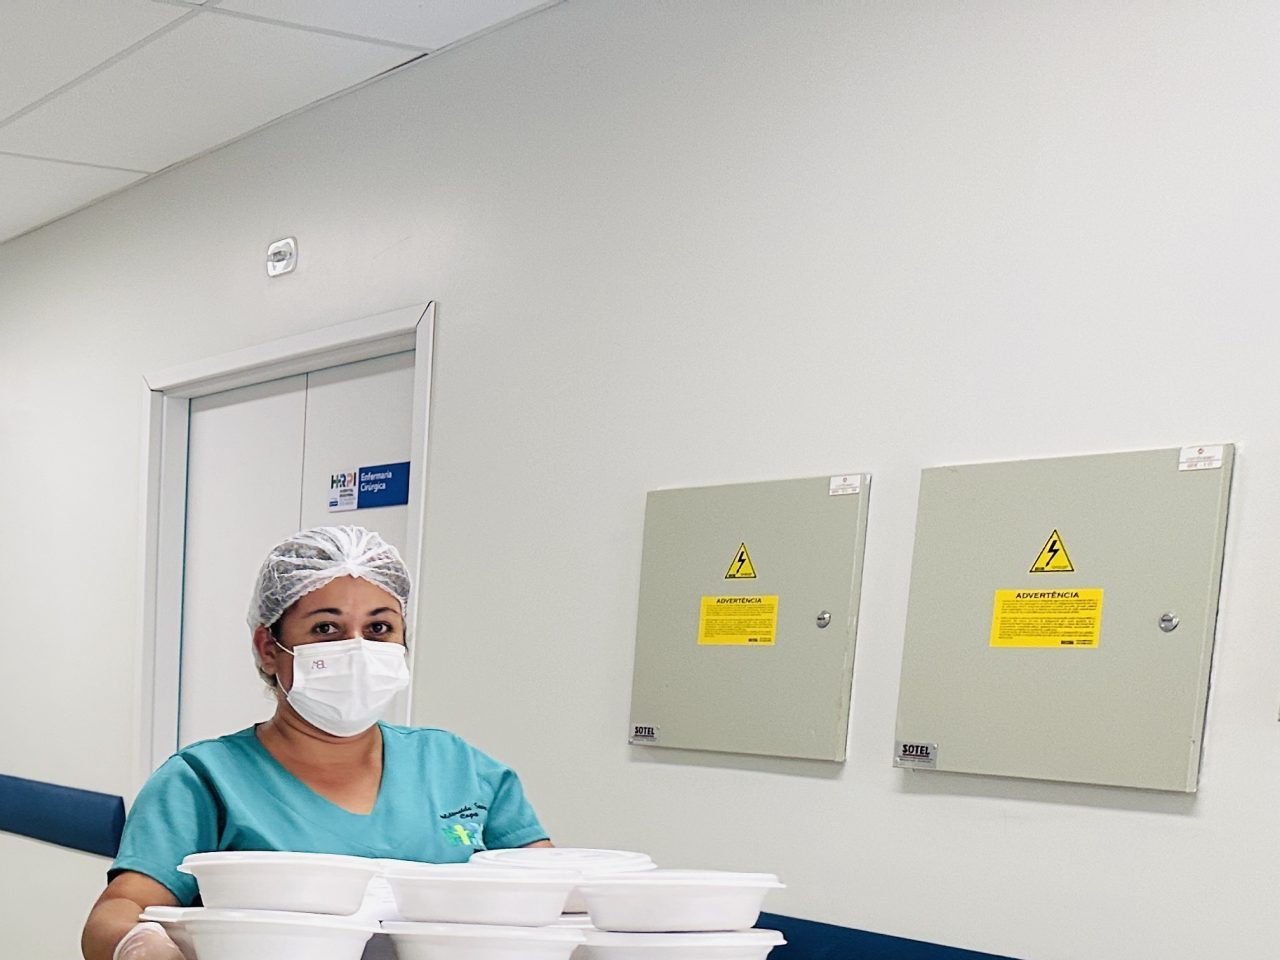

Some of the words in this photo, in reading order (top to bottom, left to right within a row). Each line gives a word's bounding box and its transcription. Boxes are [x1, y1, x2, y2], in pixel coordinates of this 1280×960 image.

[360, 470, 392, 481] Enfermaria
[1015, 591, 1080, 599] ADVERTÊNCIA
[634, 726, 655, 735] SOTEL
[902, 744, 930, 755] SOTEL
